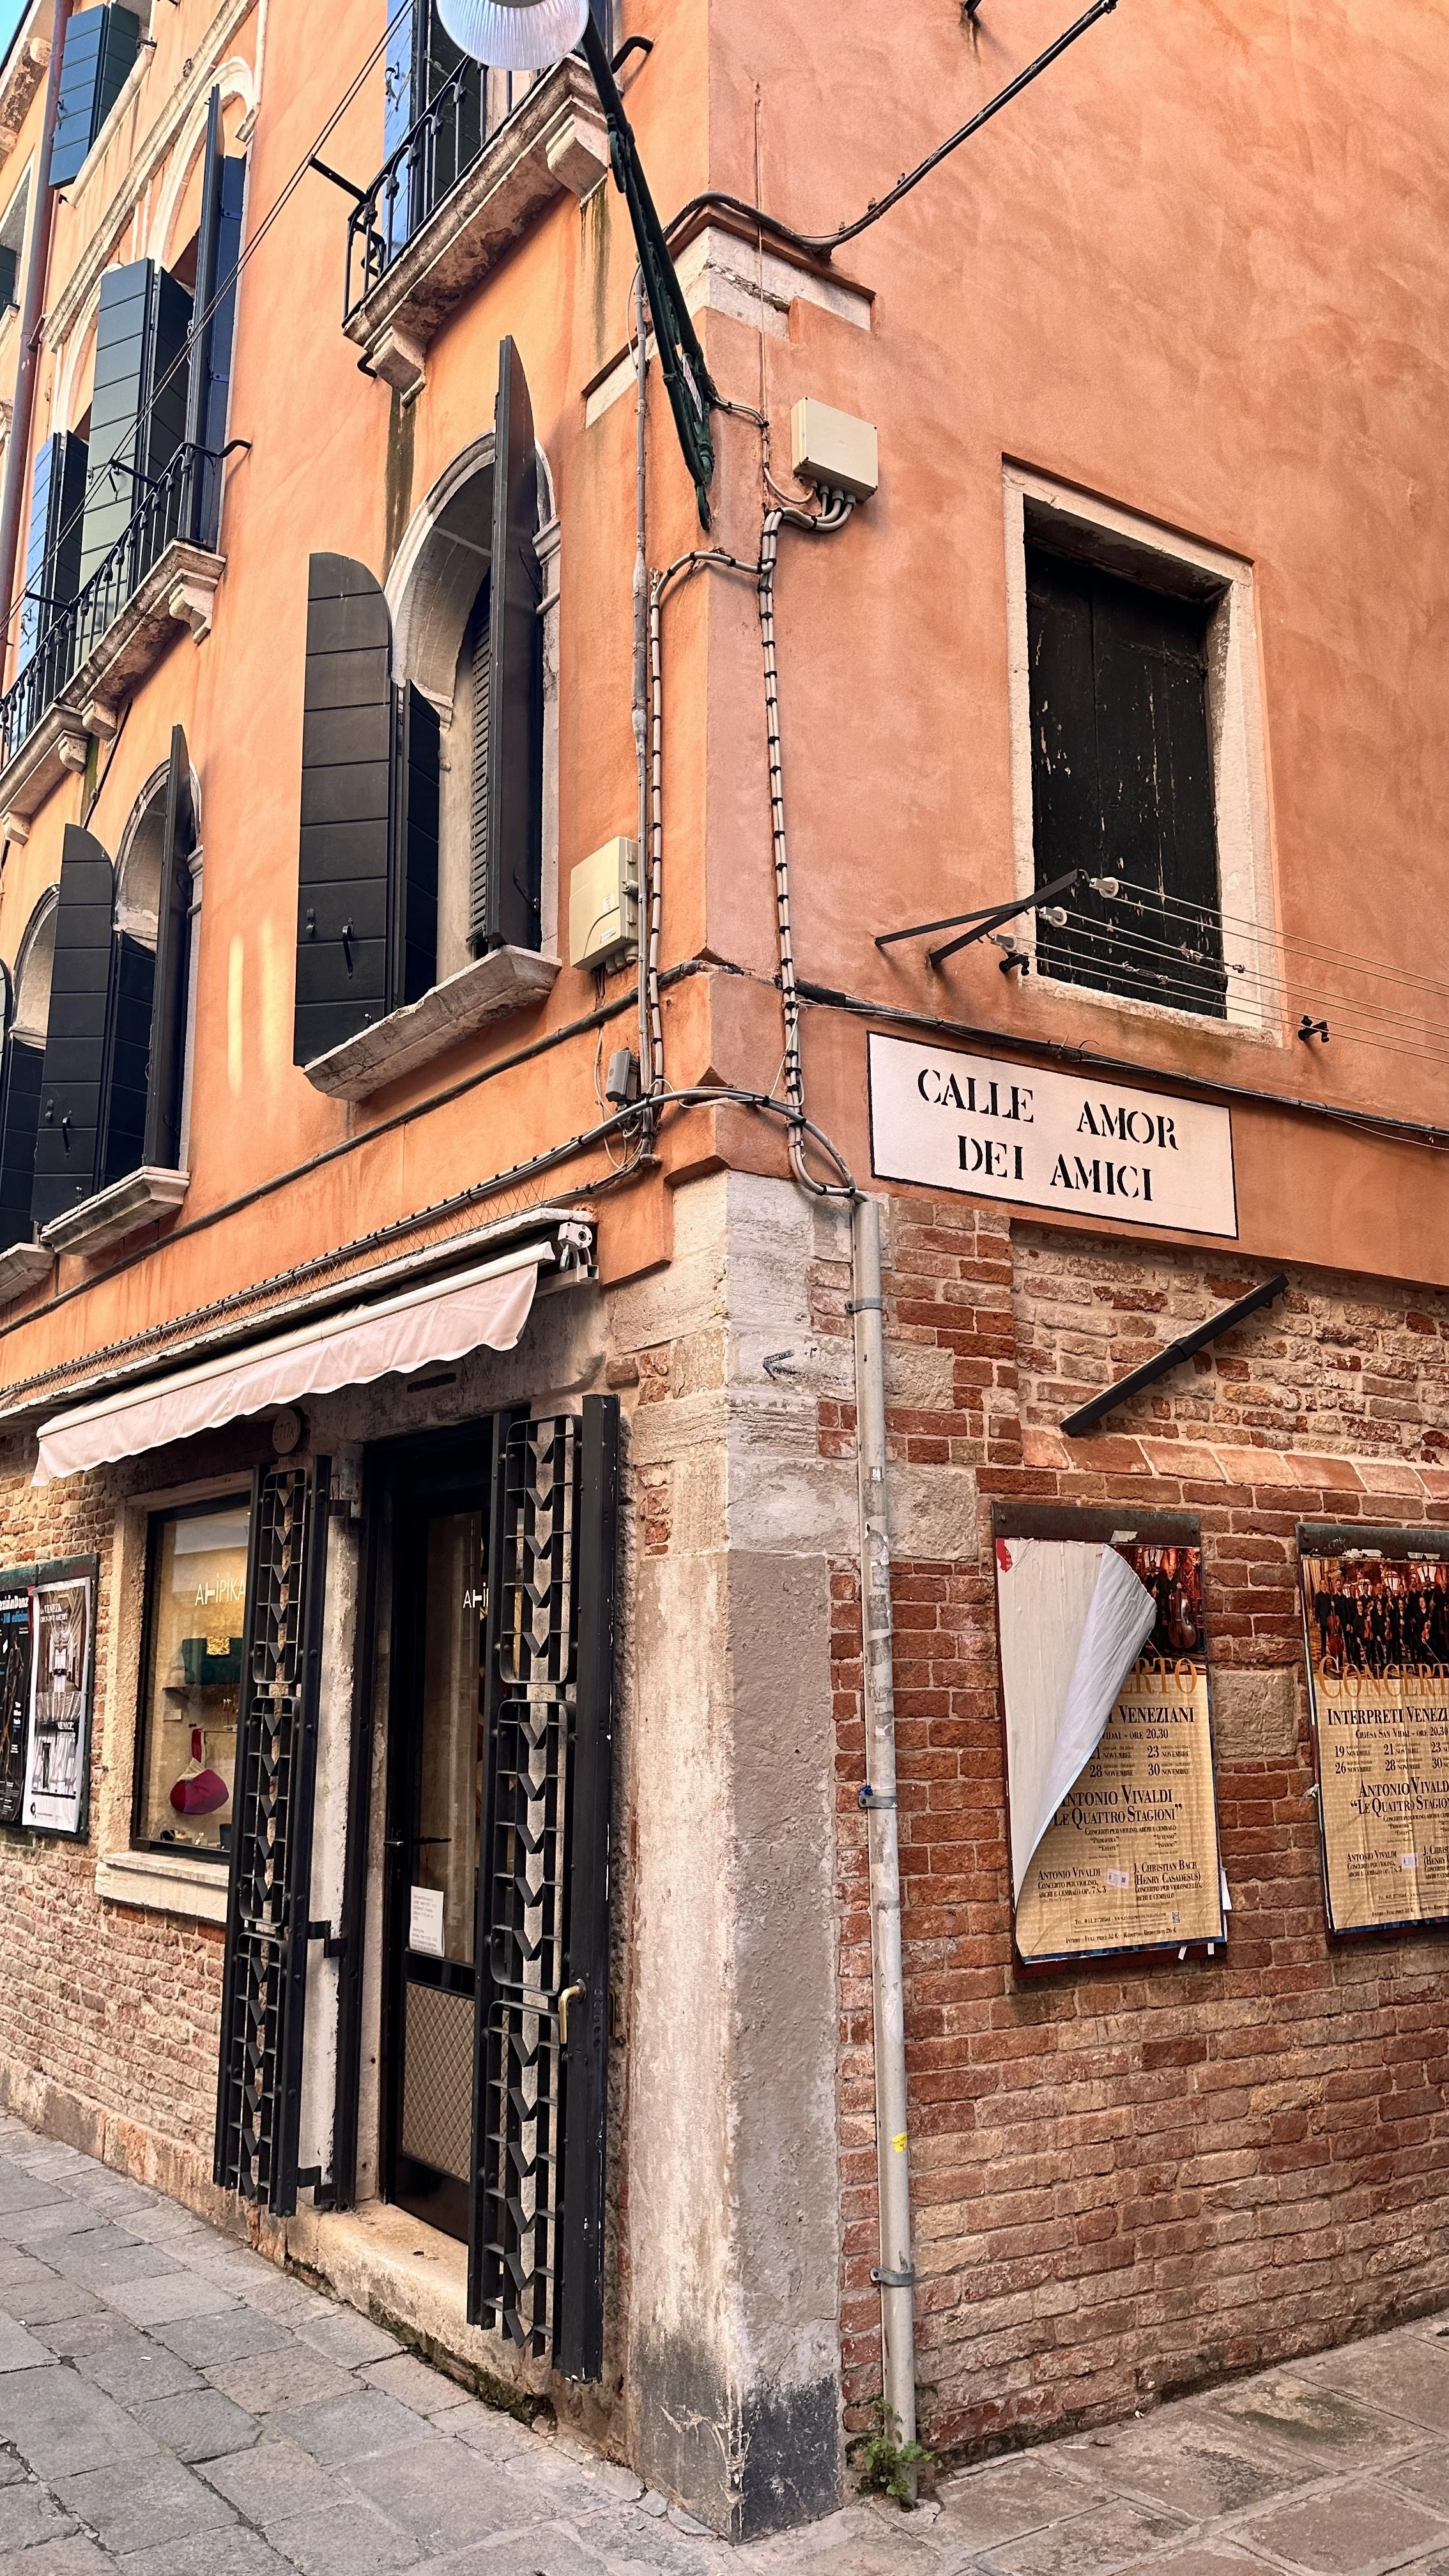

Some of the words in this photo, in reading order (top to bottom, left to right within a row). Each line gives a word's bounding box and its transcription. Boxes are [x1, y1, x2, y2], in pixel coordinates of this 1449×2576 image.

[917, 1068, 1034, 1123] CALLE
[1077, 1101, 1179, 1150] AMOR
[958, 1135, 1023, 1180] DEI
[1050, 1153, 1153, 1201] AMICI
[1121, 1657, 1197, 1694] RTO
[1118, 1705, 1195, 1724] VENEZIANI
[1327, 1708, 1404, 1725] INTERPRETI
[1130, 1731, 1144, 1740] ORE
[1356, 1729, 1377, 1739] CHIESA
[1378, 1729, 1390, 1738] SAN
[1147, 1745, 1160, 1758] 23
[1335, 1745, 1345, 1758] 19
[1383, 1743, 1393, 1756] 21
[1430, 1742, 1441, 1753] 23
[1148, 1763, 1160, 1776] 30
[1335, 1761, 1346, 1774] 26
[1385, 1759, 1396, 1772] 28
[1432, 1758, 1443, 1769] 30
[1089, 1764, 1103, 1777] 28
[1121, 1784, 1173, 1804] VIVALDI
[1358, 1780, 1410, 1798] ANTONIO
[1372, 1797, 1414, 1818] QUATTRO
[1071, 1807, 1126, 1830] QUATTRO
[1347, 1853, 1374, 1862] ANTONIO
[1374, 1850, 1397, 1859] VIVALDI
[1038, 1869, 1071, 1880] ANTONIO
[1072, 1866, 1101, 1877] VIVALDI
[1133, 1862, 1140, 1874] J.
[1141, 1862, 1177, 1873] CHRISTIAN
[1179, 1859, 1197, 1871] BACH
[1135, 1874, 1160, 1885] (HENRY
[1162, 1871, 1201, 1883] CASADESUS)
[1038, 1881, 1066, 1889] CONCERTO
[1135, 1885, 1160, 1893] CONCERTO
